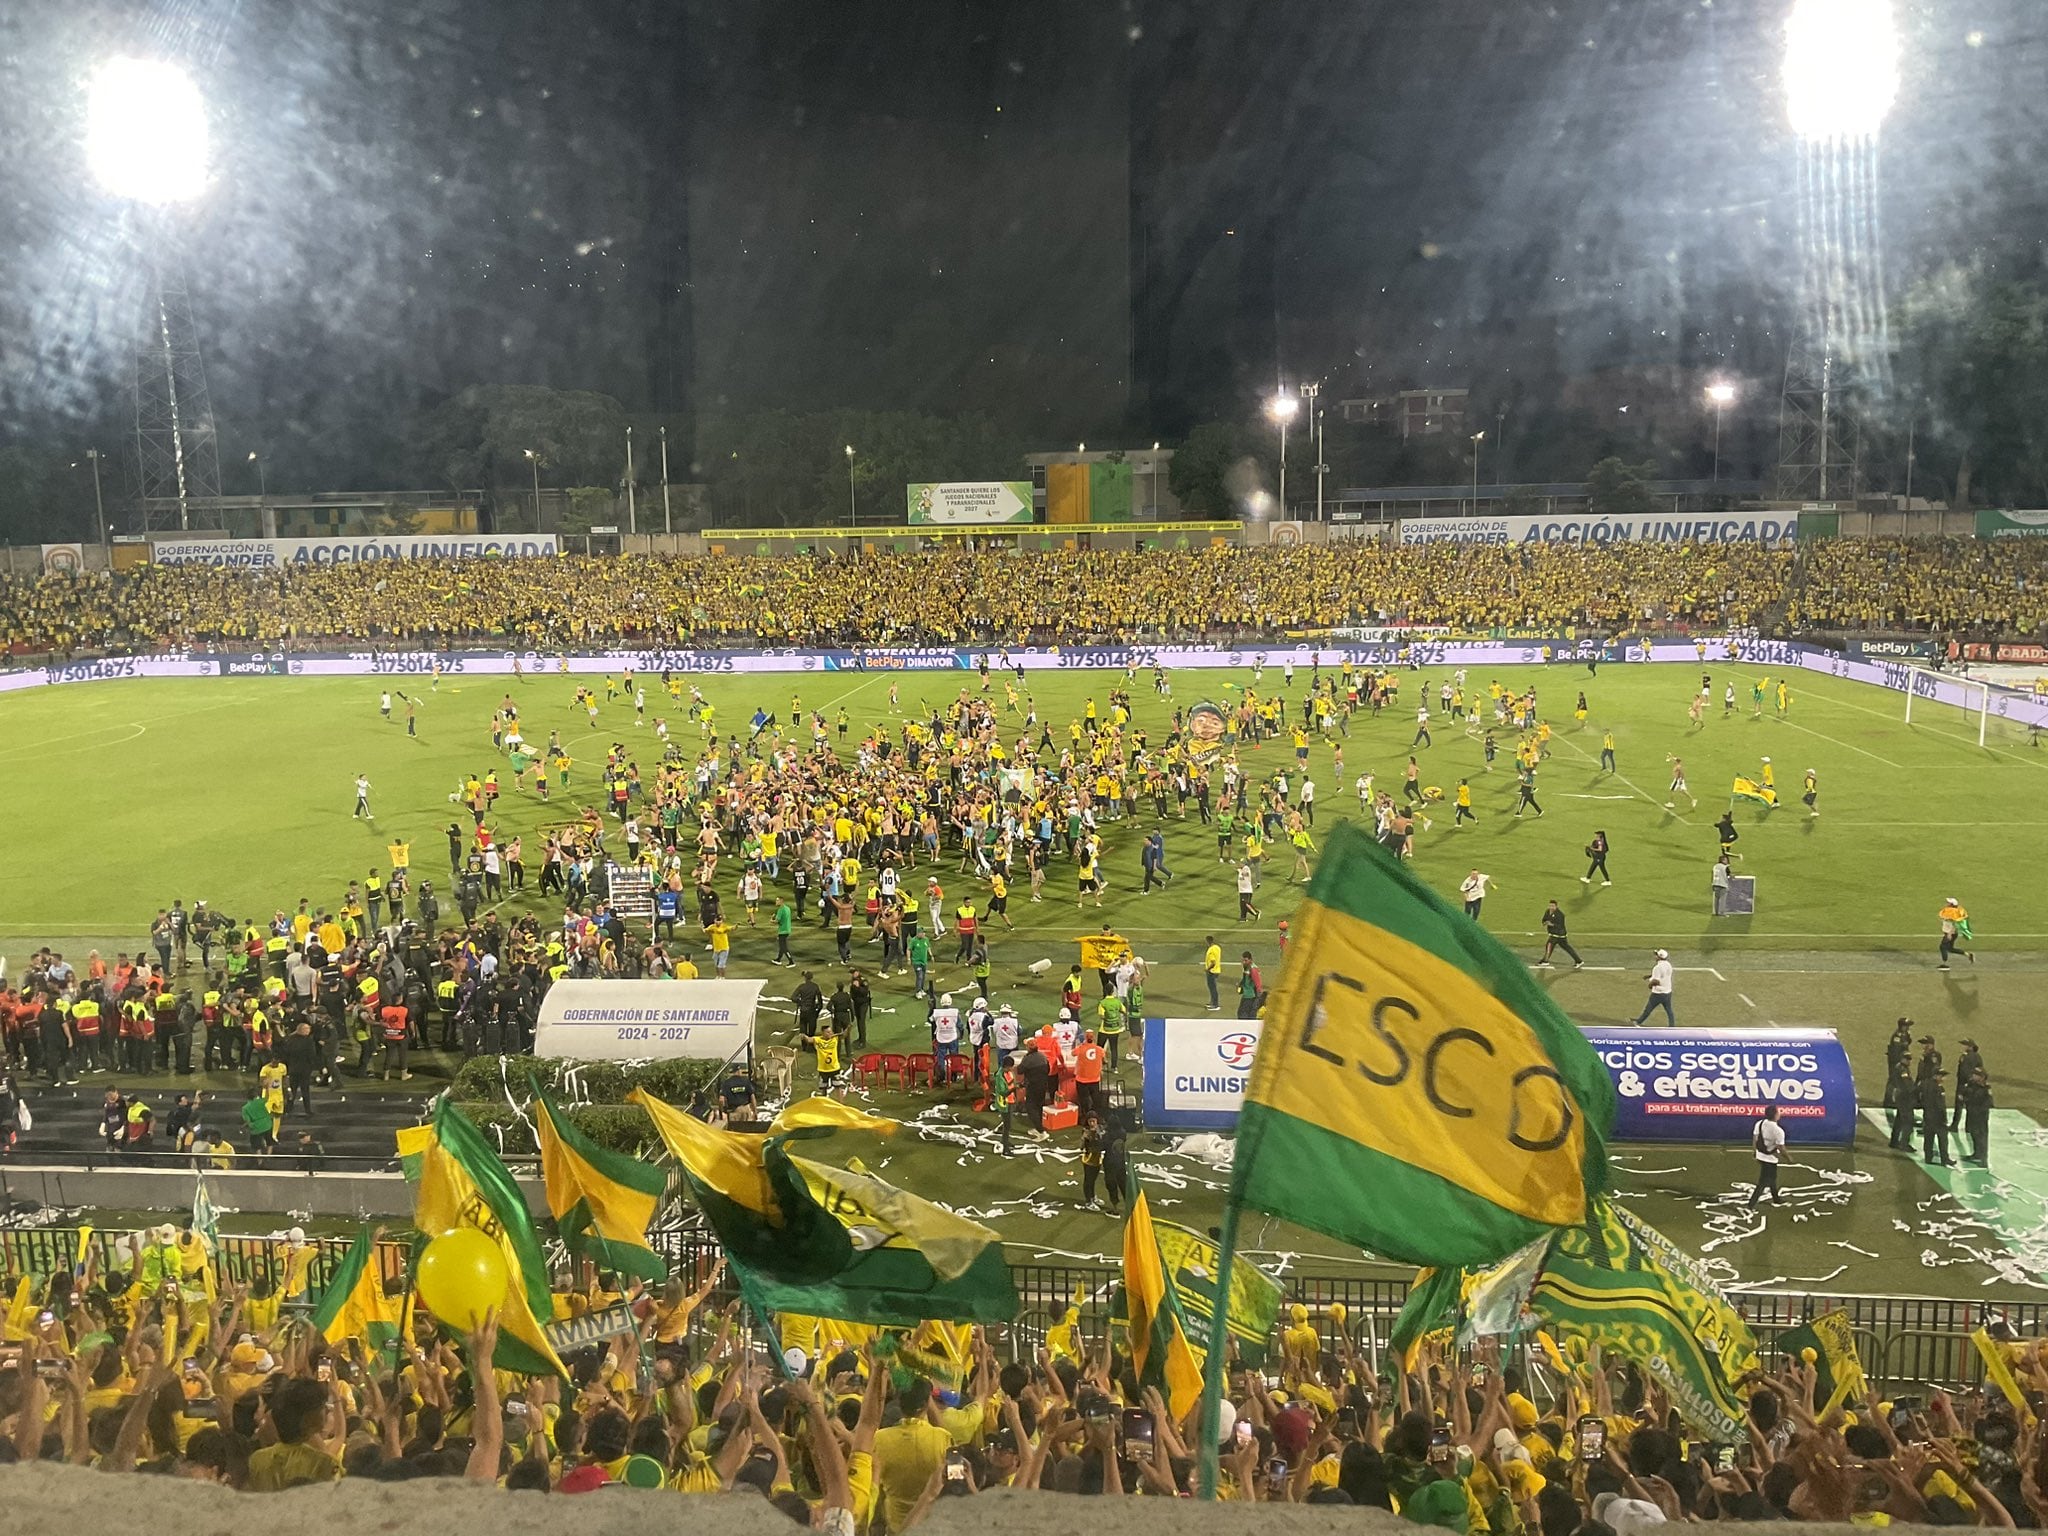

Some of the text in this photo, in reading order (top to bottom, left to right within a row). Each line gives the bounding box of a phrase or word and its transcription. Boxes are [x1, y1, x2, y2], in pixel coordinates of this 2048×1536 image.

[1402, 521, 1508, 534] GOBERNACIÓN DE
[1524, 516, 1797, 545] ACCIÓN UNIFICADA
[157, 543, 274, 556] GOBERNACIÓN DE
[294, 539, 557, 562] ACCIÓN UNIFICADA
[1862, 642, 1909, 659] BetPlay
[231, 661, 267, 674] BetPlay
[638, 658, 733, 671] 3175014875
[866, 656, 905, 669] BetPlay
[907, 657, 954, 668] DIMAYOR
[1884, 669, 1937, 698] 317504875
[885, 876, 893, 885] 10
[563, 1008, 730, 1021] GOBERNACIÓN DE SANTANDER
[618, 1028, 649, 1040] 2024
[660, 1028, 691, 1040] 2027
[1680, 1051, 1818, 1077] seguros
[1617, 1069, 1825, 1100] & efectivos
[1648, 1105, 1671, 1114] para
[1686, 1104, 1745, 1113] tratamiento
[1747, 1106, 1755, 1115] y
[1756, 1105, 1824, 1117] reperación.
